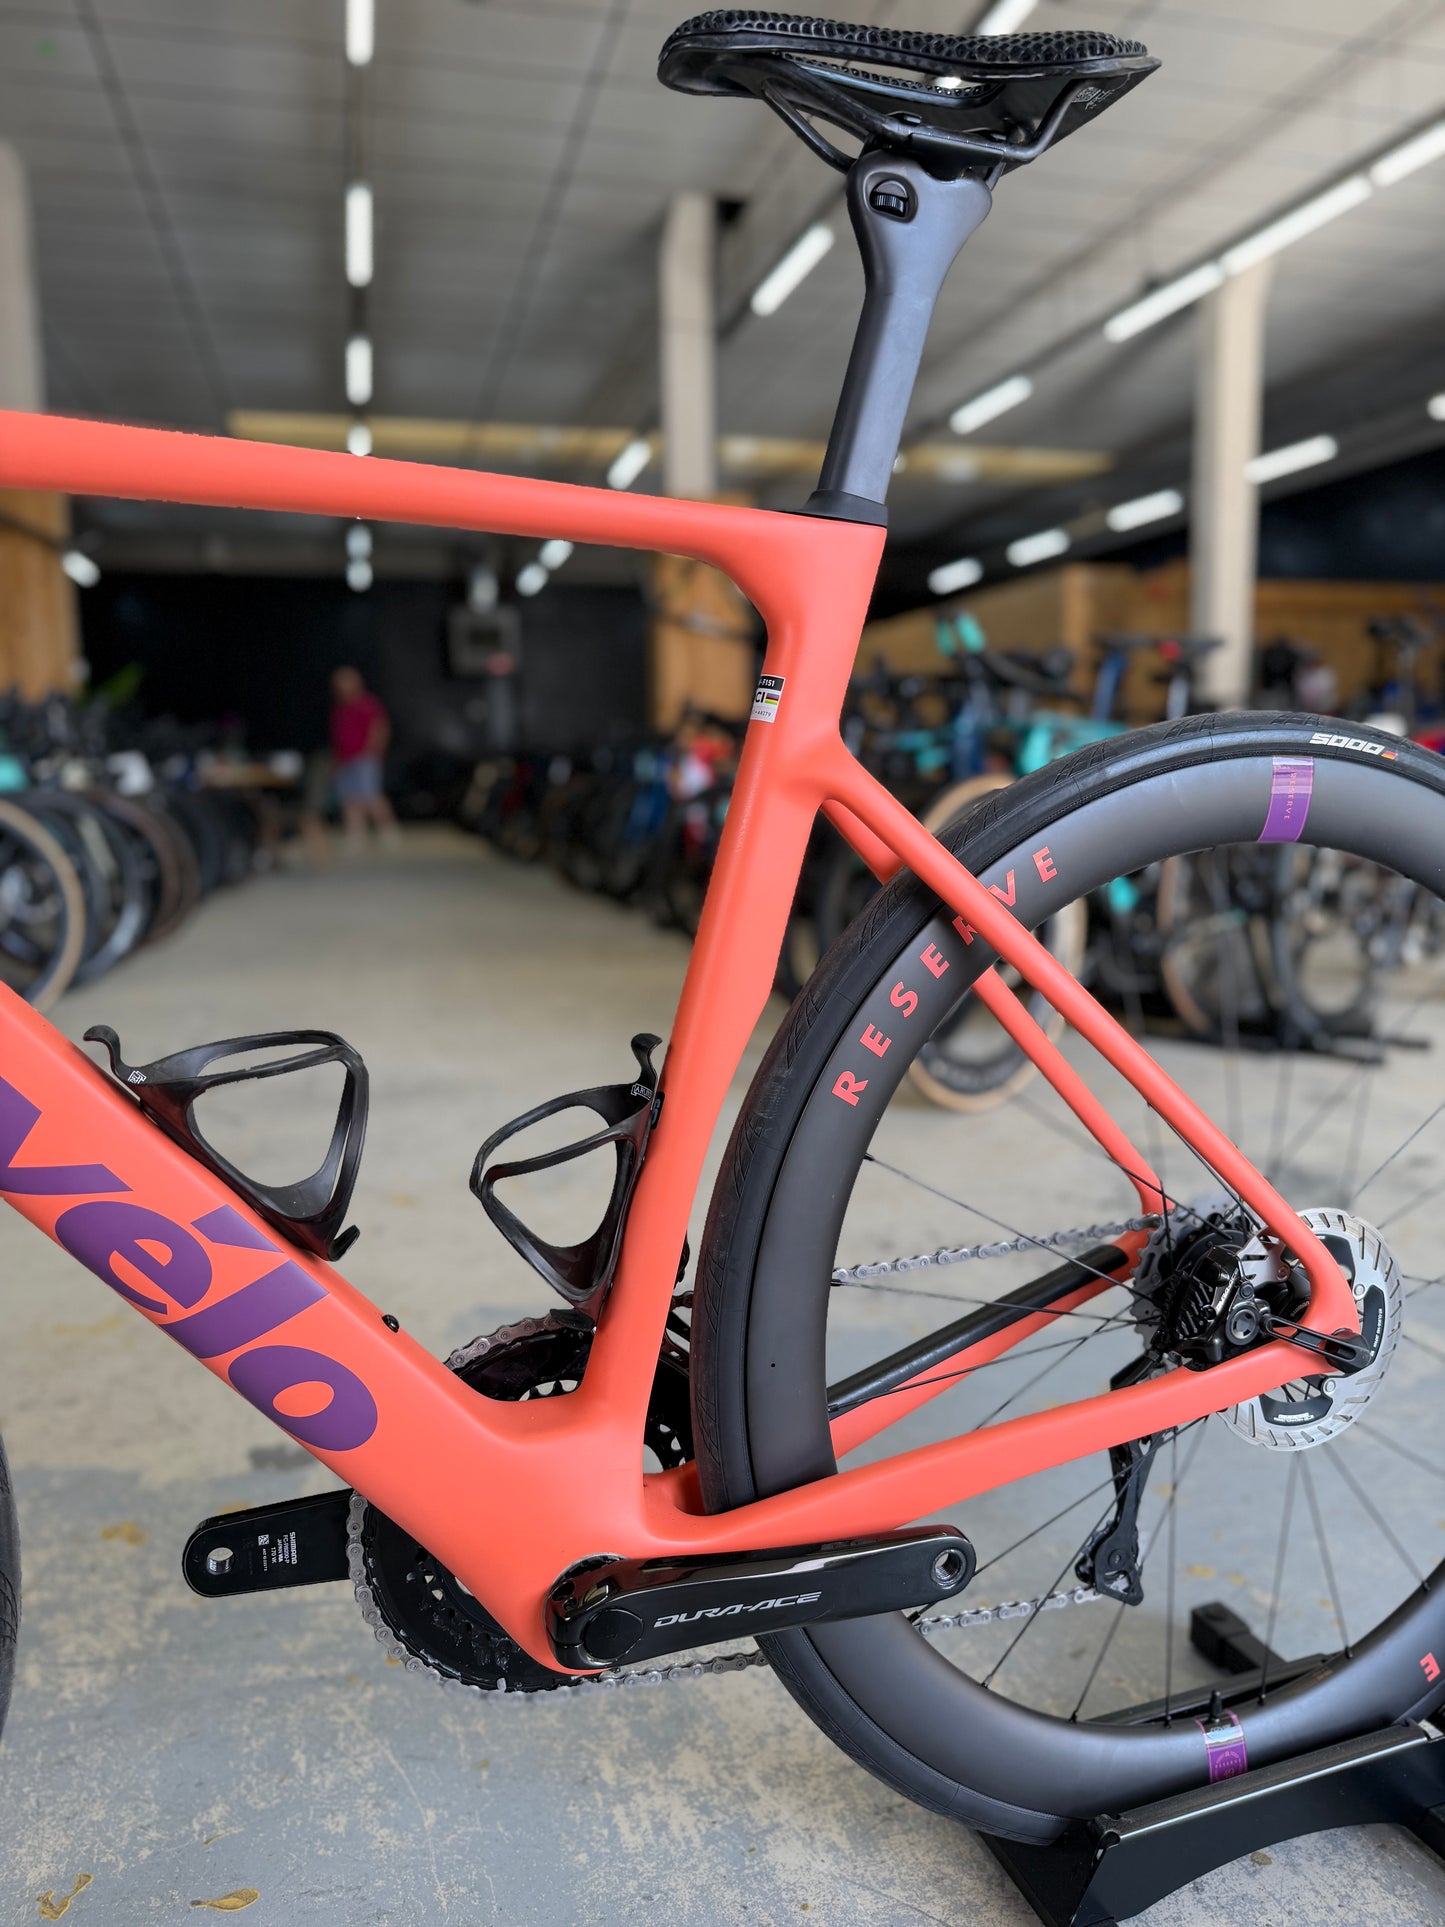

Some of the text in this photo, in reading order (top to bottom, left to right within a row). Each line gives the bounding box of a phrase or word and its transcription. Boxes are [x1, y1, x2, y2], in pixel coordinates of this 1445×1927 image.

[1309, 733, 1385, 755] 5000
[1283, 772, 1297, 820] RESERVE
[289, 1531, 298, 1565] SHIMANO
[654, 1591, 822, 1628] DURA-ACE
